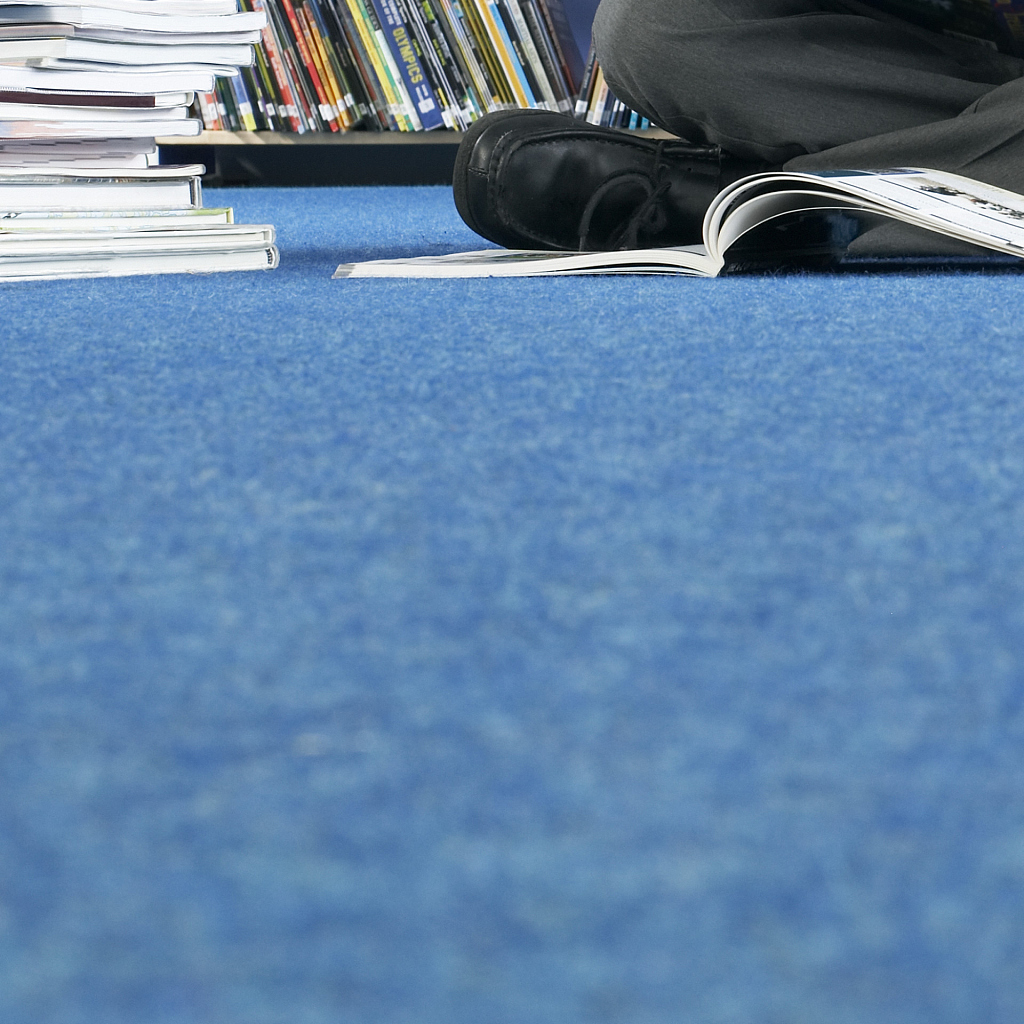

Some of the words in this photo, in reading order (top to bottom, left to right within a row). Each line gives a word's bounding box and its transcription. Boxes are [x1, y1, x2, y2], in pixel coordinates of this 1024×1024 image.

[386, 15, 394, 25] THE
[387, 0, 401, 26] COMPLETE
[397, 5, 408, 23] Sports
[391, 26, 424, 84] OLYMPICS
